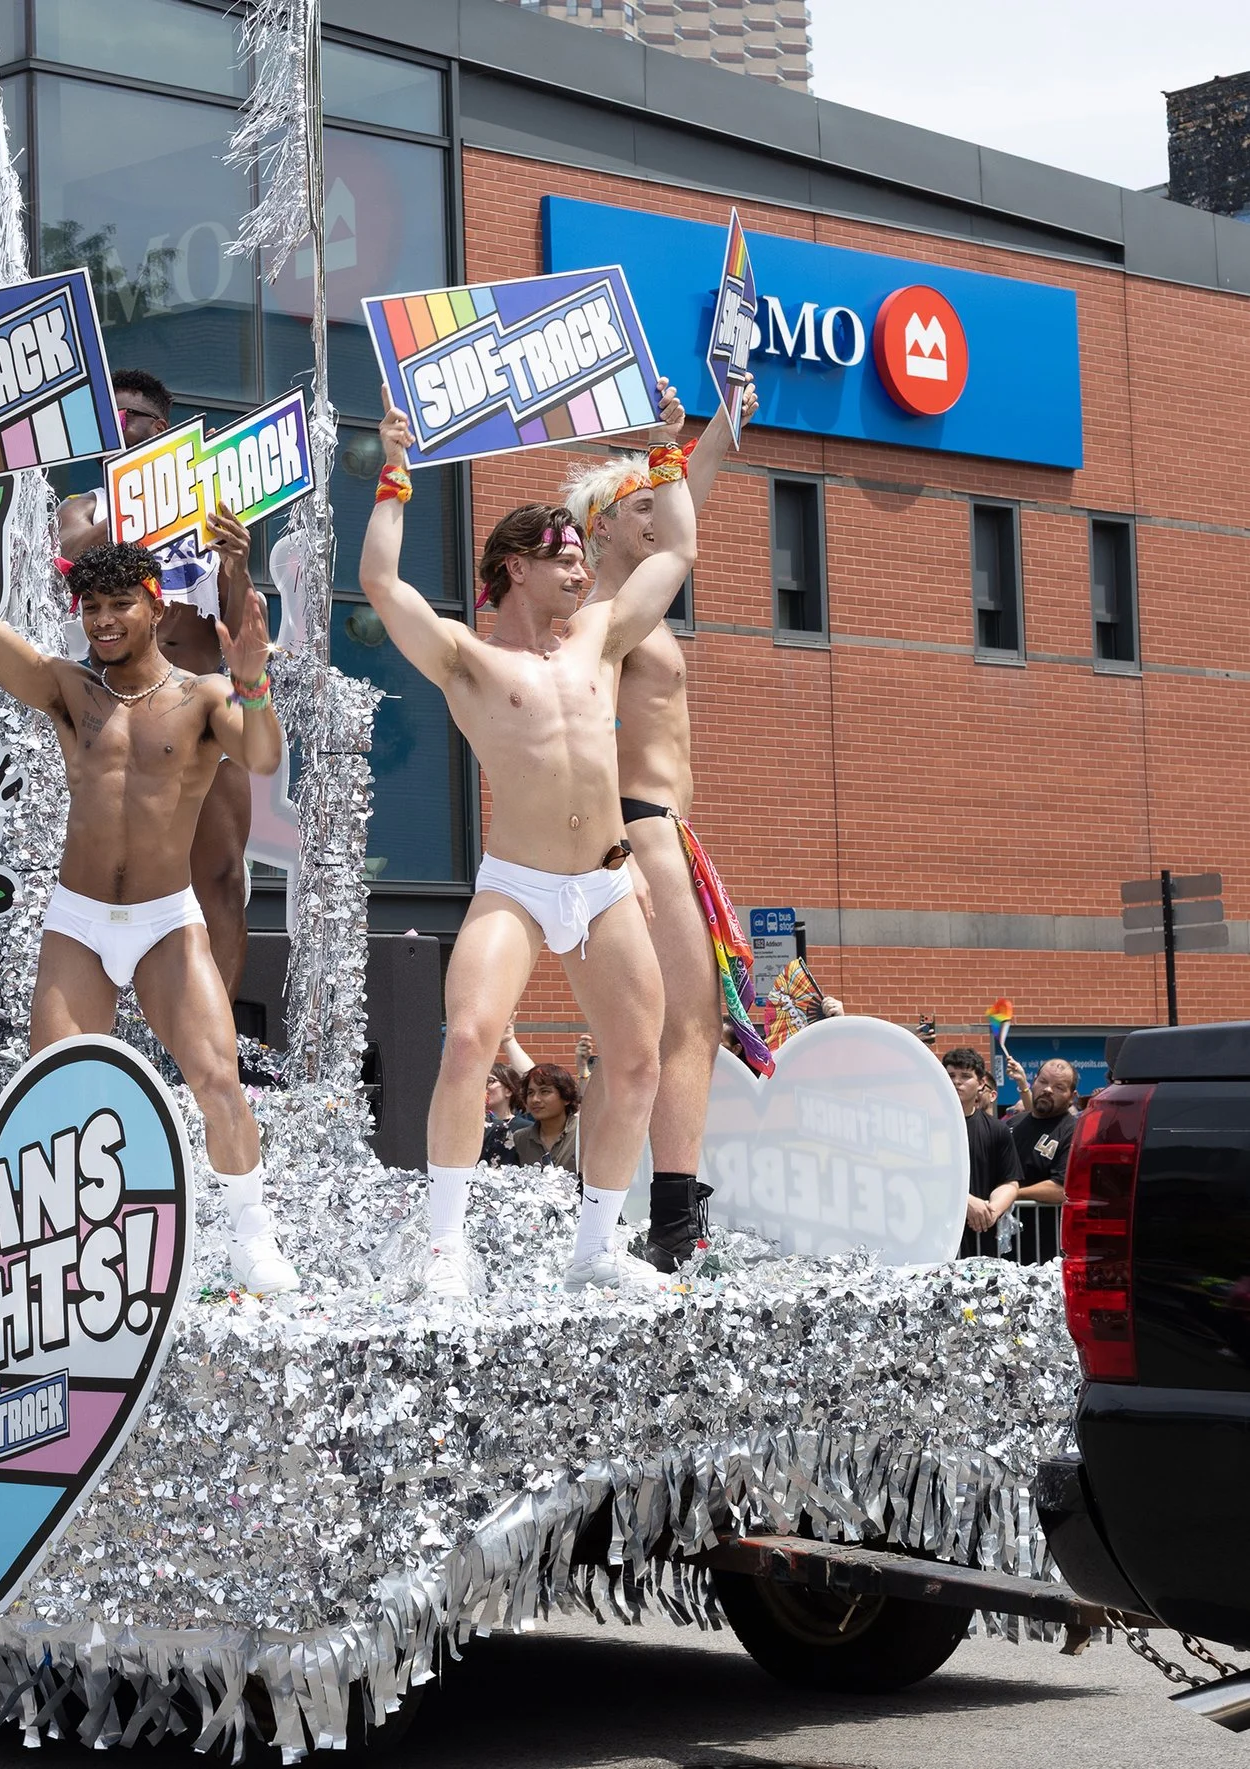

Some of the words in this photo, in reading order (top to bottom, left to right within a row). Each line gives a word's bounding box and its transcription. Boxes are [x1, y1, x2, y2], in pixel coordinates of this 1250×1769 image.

[101, 220, 234, 328] MO
[414, 298, 622, 427] SIDETRACK
[116, 411, 302, 540] SIDETRACK
[778, 912, 792, 921] bus
[1034, 1133, 1059, 1160] LA
